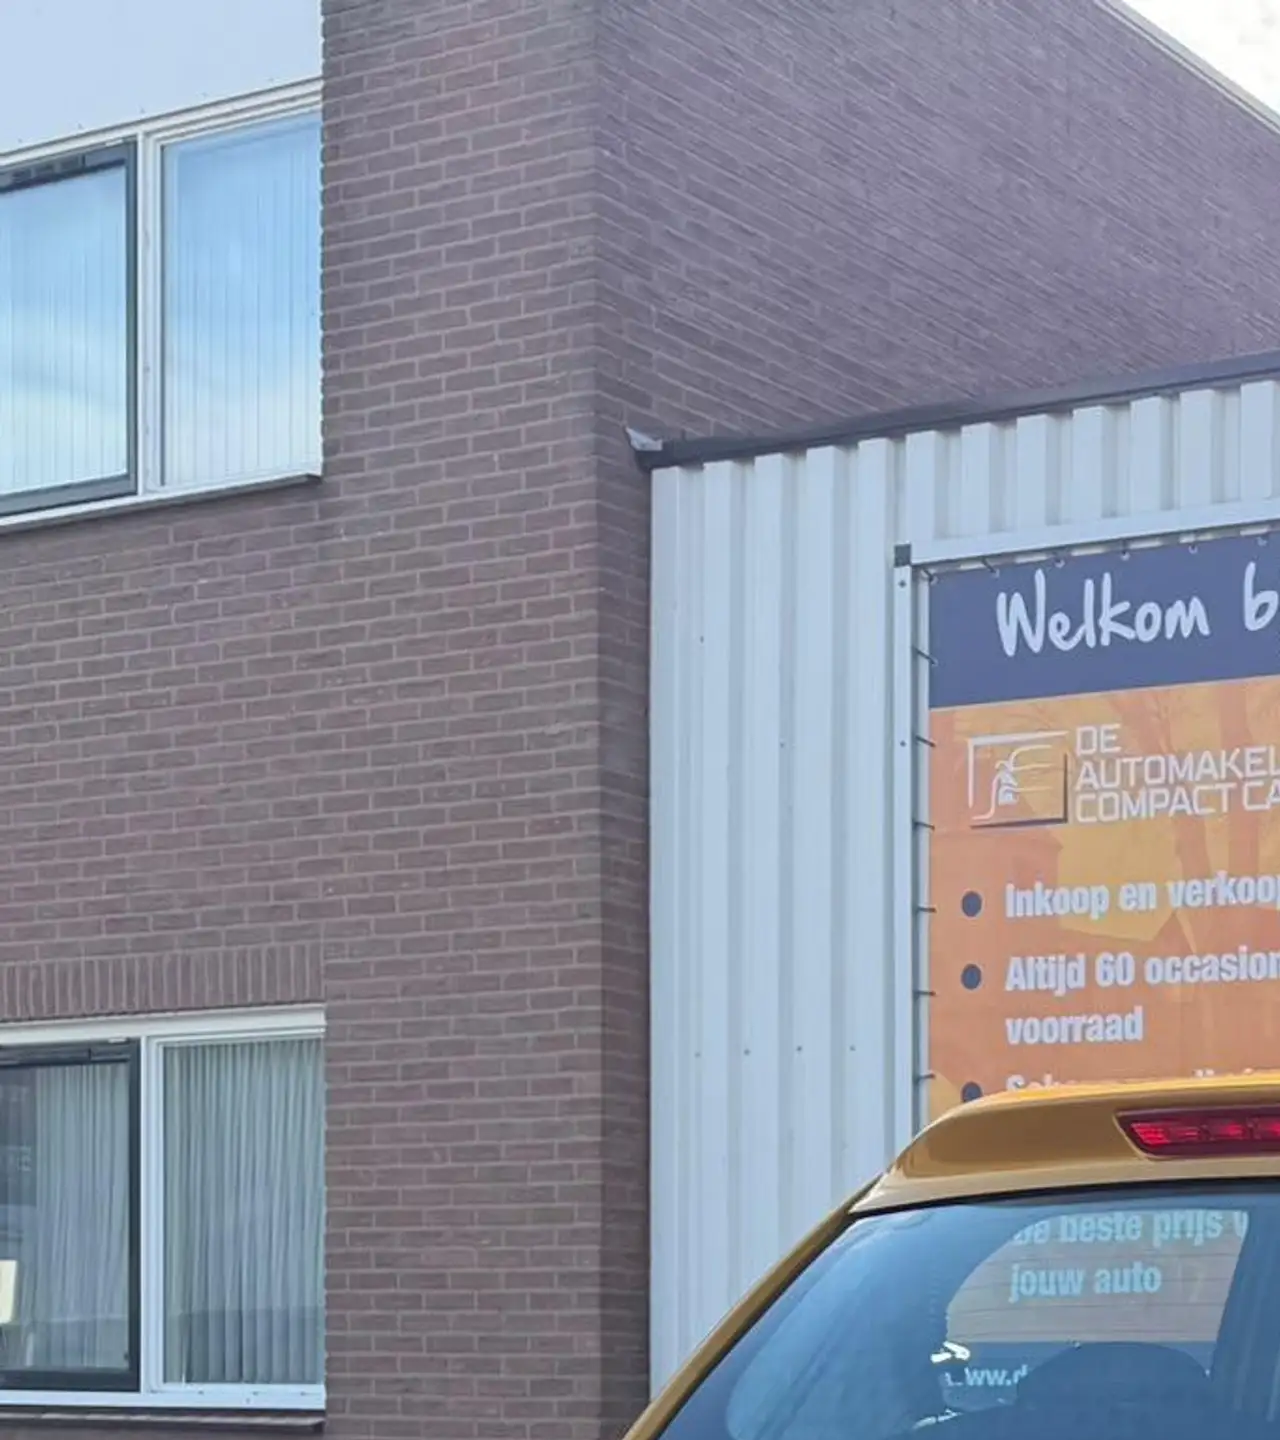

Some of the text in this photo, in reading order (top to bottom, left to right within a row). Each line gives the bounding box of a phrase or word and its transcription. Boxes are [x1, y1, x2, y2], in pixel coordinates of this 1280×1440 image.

[996, 569, 1211, 657] Welkom
[1075, 723, 1122, 757] DE
[1076, 782, 1238, 824] COMPACT
[1005, 880, 1109, 921] Inkoop
[1119, 882, 1157, 911] en
[1005, 954, 1087, 997] Altijd
[1095, 952, 1137, 988] 60
[1005, 1005, 1144, 1045] voorraad
[1008, 1260, 1163, 1304] jouw auto
